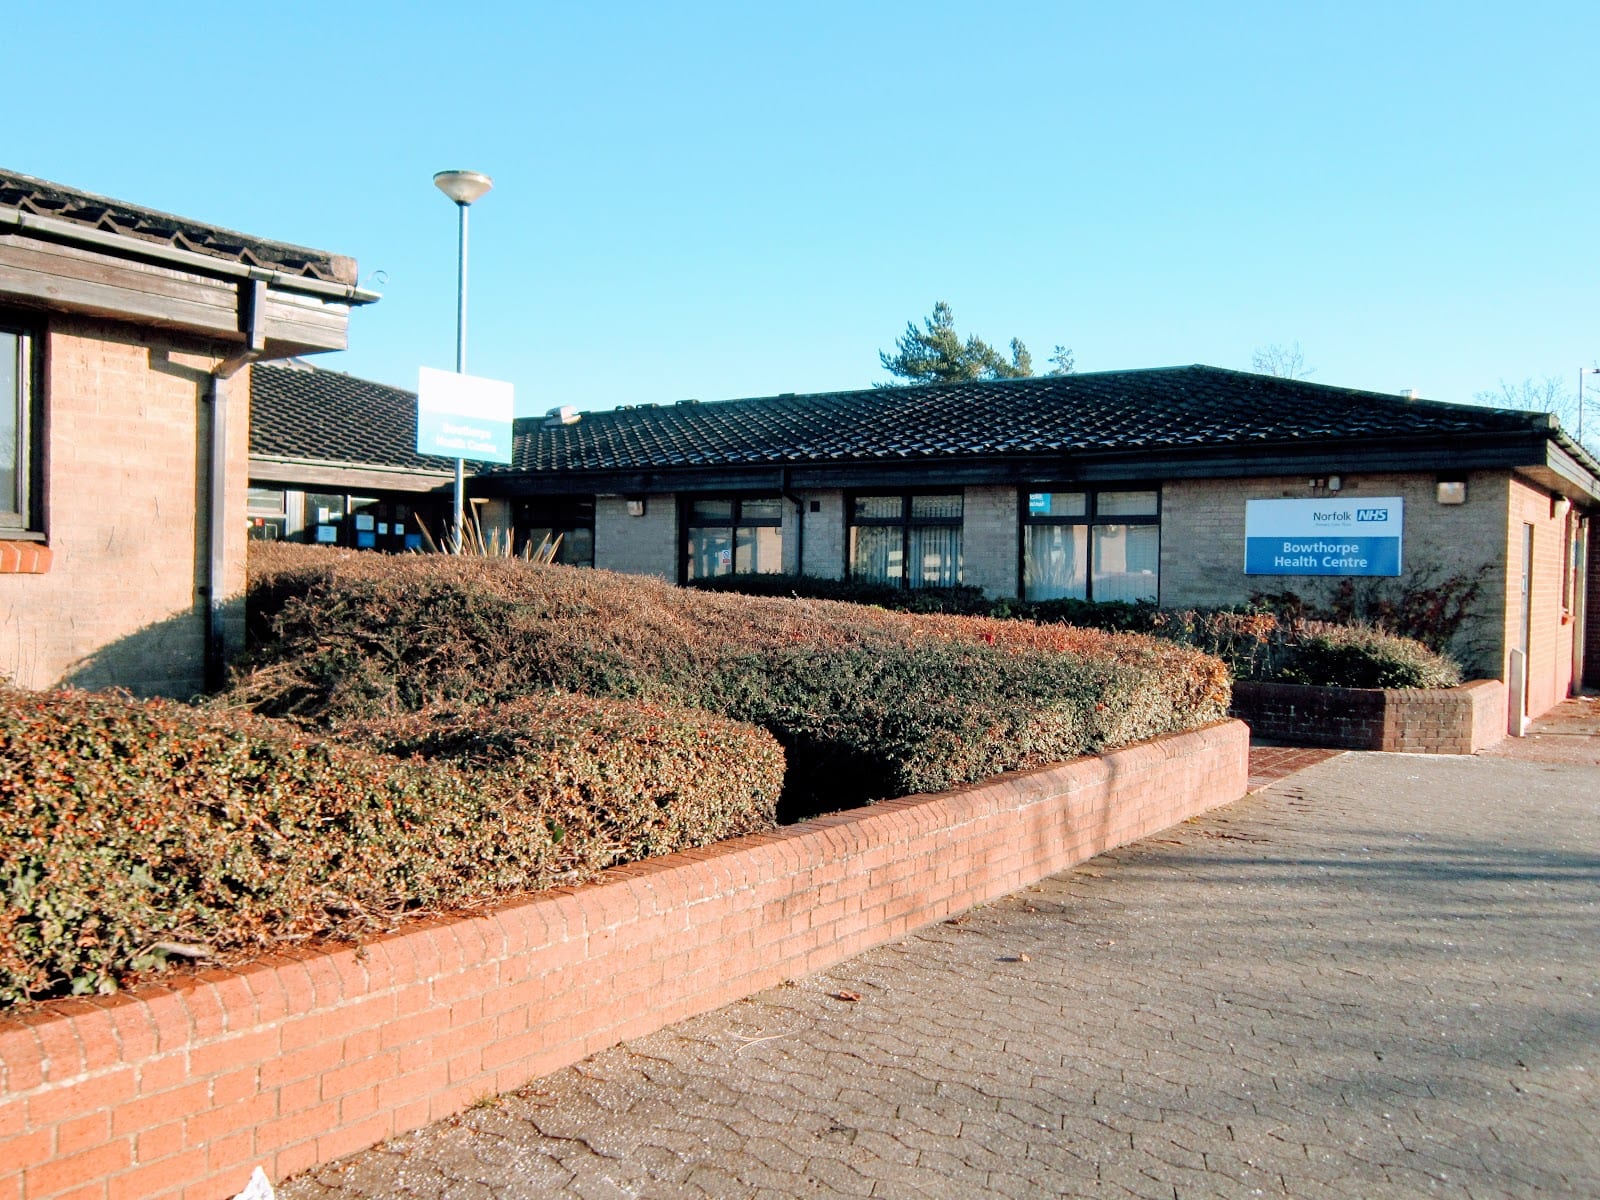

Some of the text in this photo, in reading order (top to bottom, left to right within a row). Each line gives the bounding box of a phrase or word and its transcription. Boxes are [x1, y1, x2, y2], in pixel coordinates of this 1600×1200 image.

[1313, 510, 1387, 521] Norfolk NHS
[1283, 542, 1359, 555] Bowthorpe
[1274, 556, 1368, 568] Health Centre
